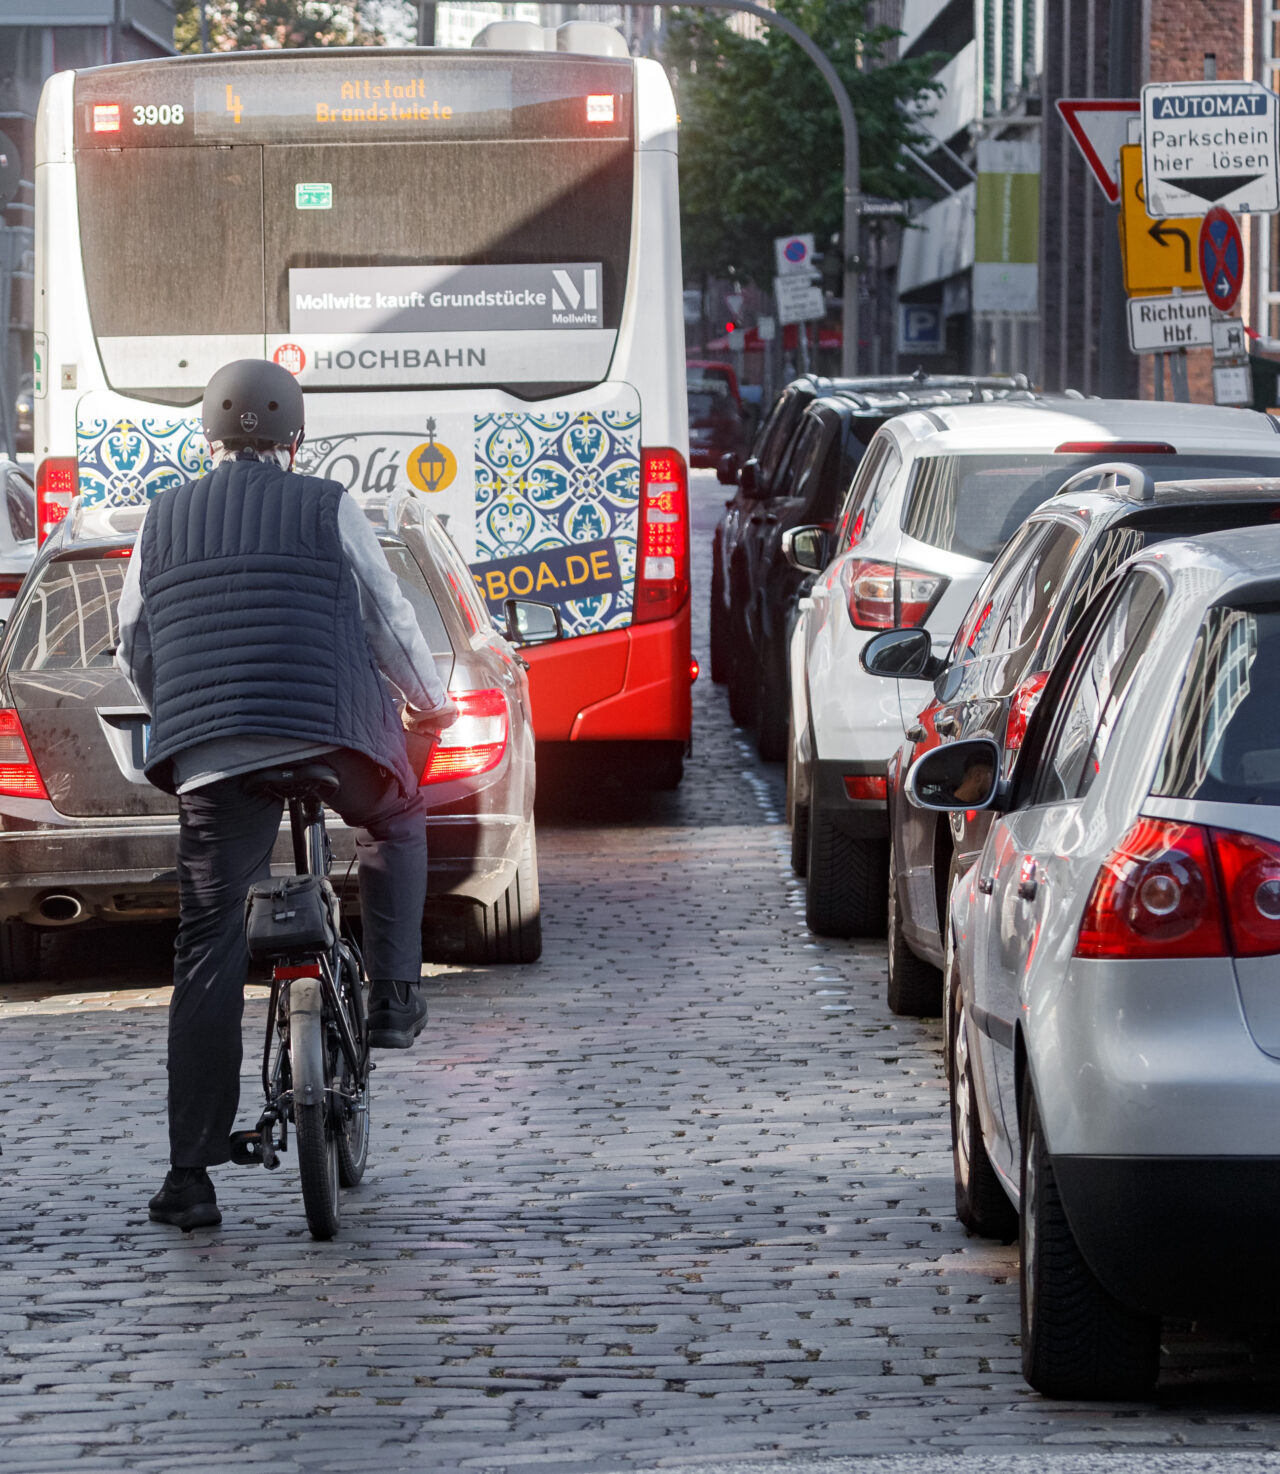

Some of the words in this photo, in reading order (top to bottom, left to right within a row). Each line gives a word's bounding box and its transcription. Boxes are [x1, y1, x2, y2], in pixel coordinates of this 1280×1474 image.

[340, 79, 426, 100] Altstadt
[225, 84, 244, 124] 4
[315, 101, 454, 123] Brandstwiete
[1160, 96, 1260, 118] AUTOMAT
[132, 104, 185, 127] 3908
[1152, 127, 1269, 148] Parkschein
[1153, 154, 1194, 172] hier
[1212, 151, 1270, 170] lösen
[295, 294, 372, 312] Mollwitz
[375, 290, 425, 310] kauft
[430, 289, 547, 308] Grundstücke
[552, 313, 598, 325] Mollwitz
[1163, 323, 1198, 343] Hbf.
[314, 347, 487, 371] HOCHBAHN
